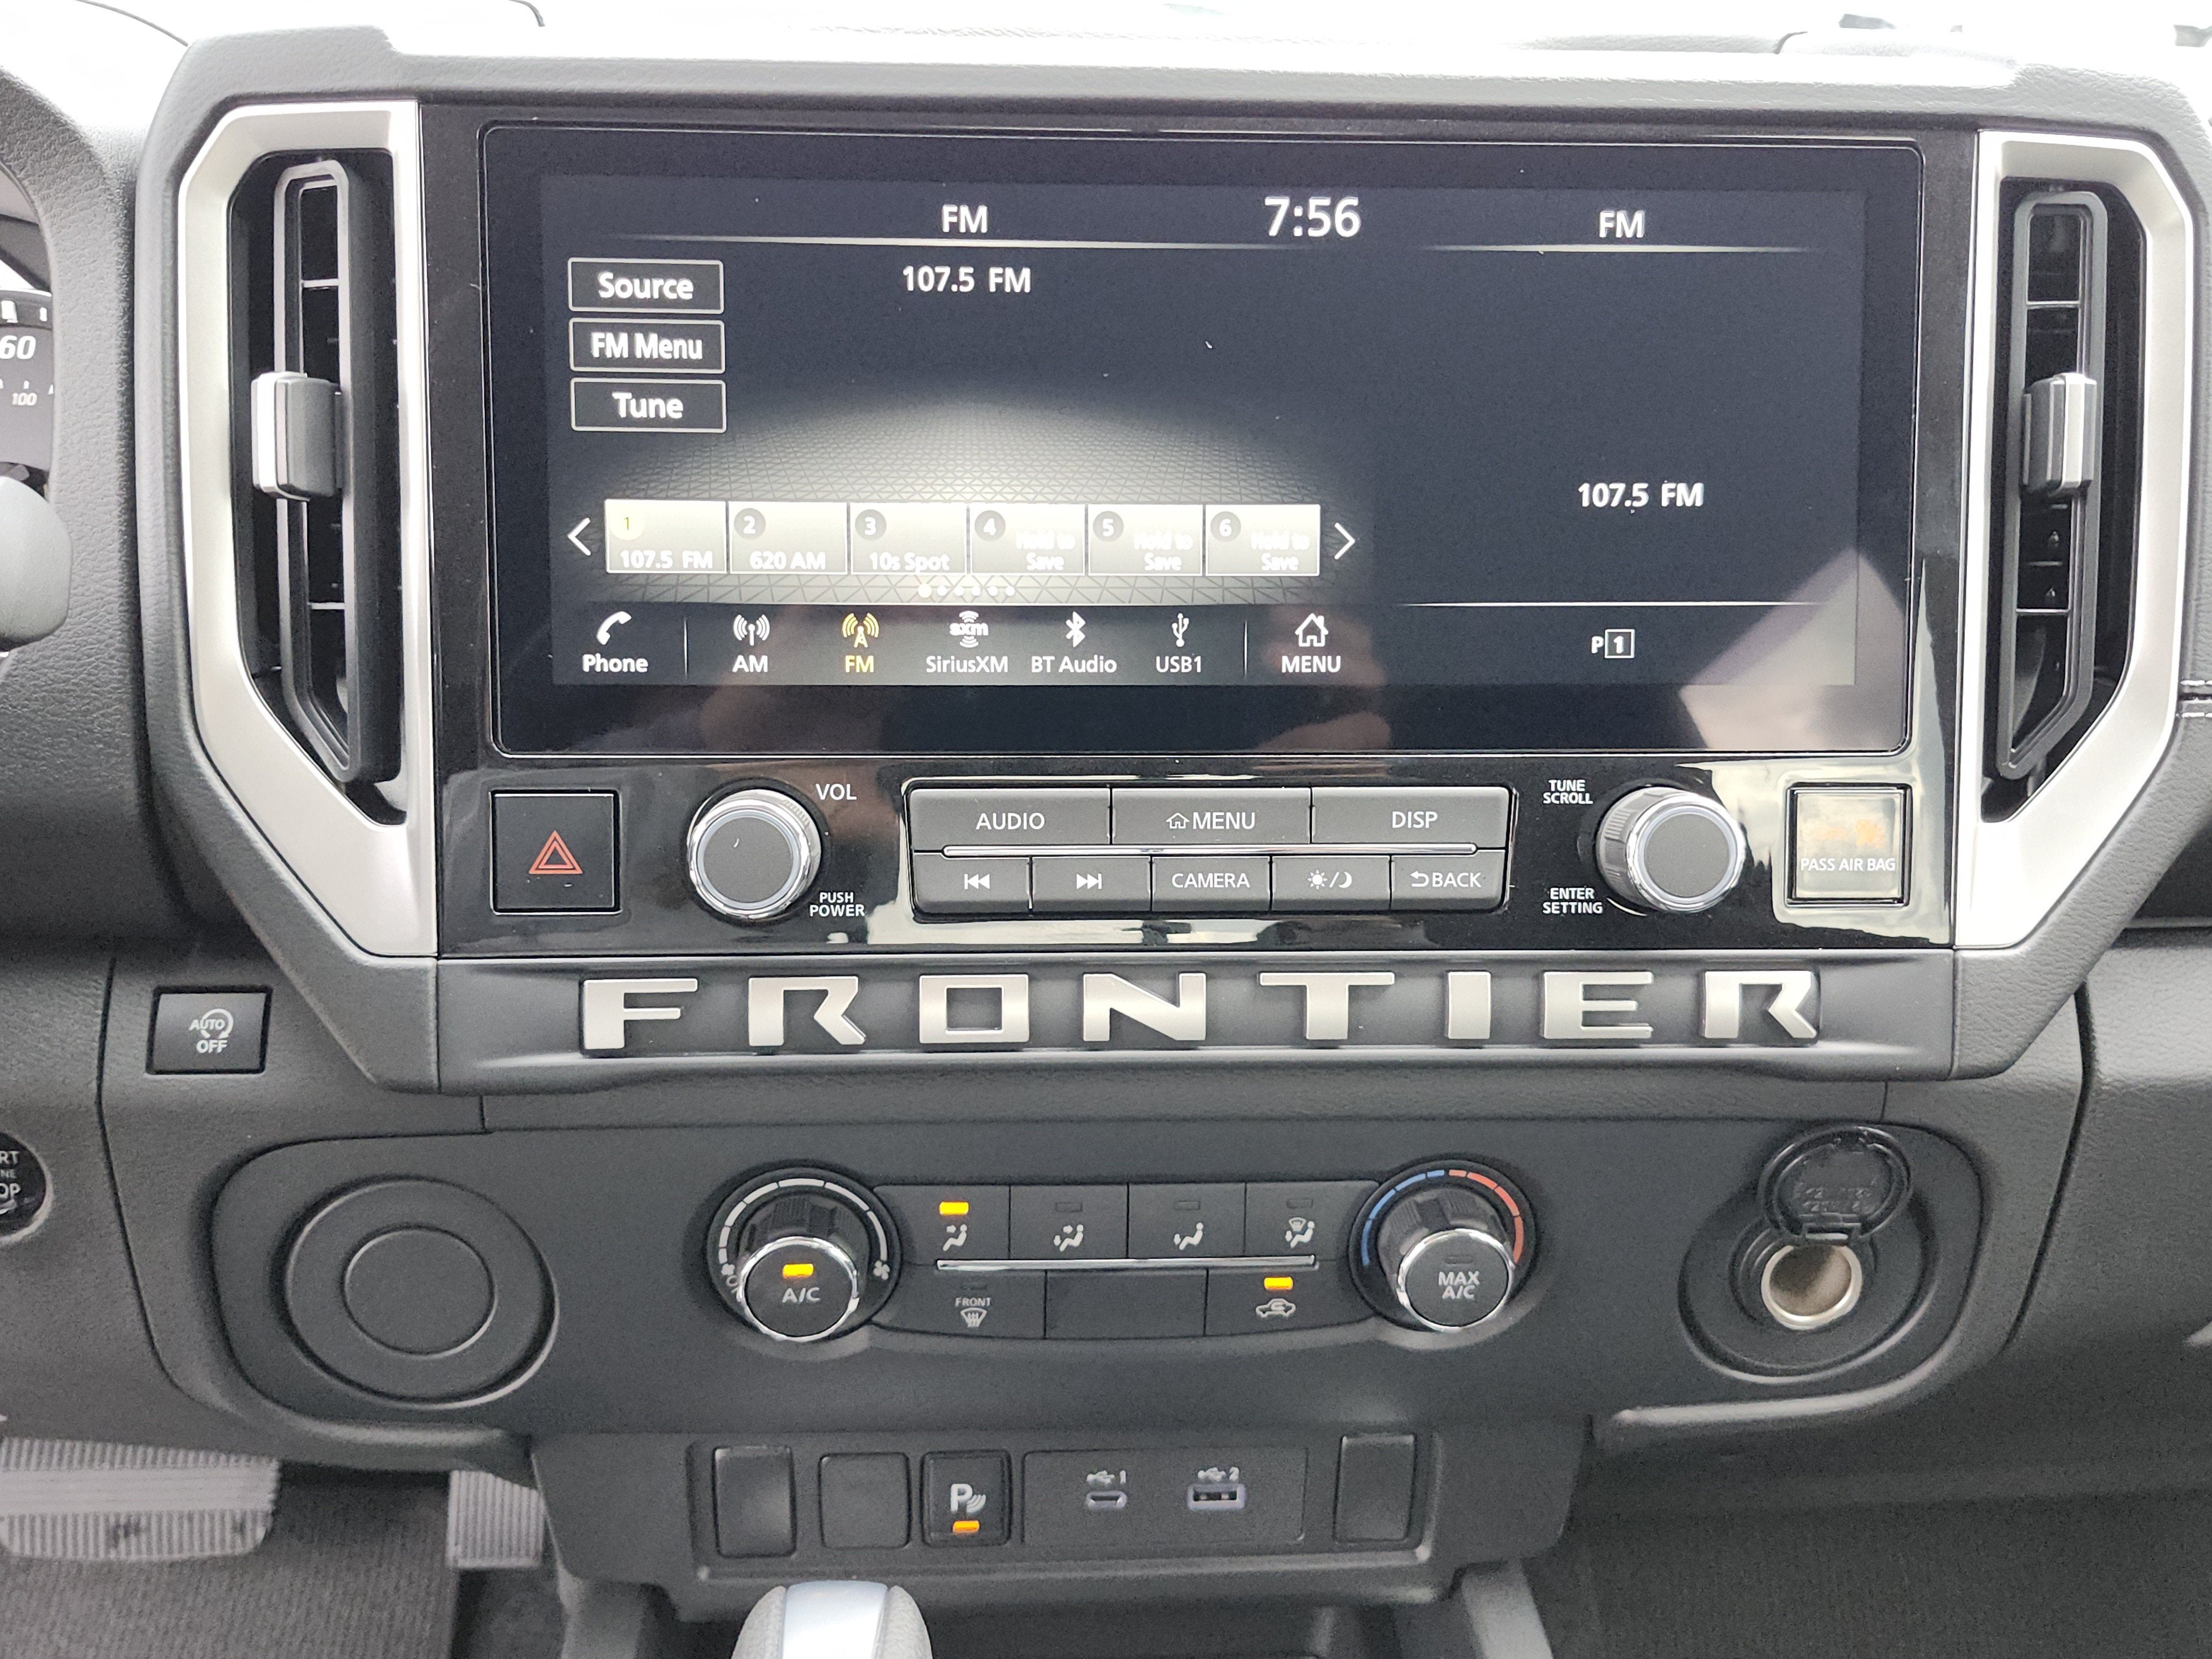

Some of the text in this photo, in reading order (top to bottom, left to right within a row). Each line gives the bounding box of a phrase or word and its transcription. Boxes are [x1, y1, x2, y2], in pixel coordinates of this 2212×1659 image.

[942, 205, 988, 233] FM
[1264, 196, 1360, 238] 7:56
[1599, 210, 1645, 238] FM
[597, 273, 693, 300] Source
[902, 266, 1031, 293] 107.5 FM
[0, 335, 36, 359] 60
[591, 333, 702, 359] FM Menu
[12, 393, 37, 405] 100
[613, 392, 684, 419] Tune
[1578, 482, 1704, 507] 107.5 FM
[623, 517, 630, 531] 1
[743, 516, 756, 534] 2
[864, 517, 877, 536] 3
[983, 518, 996, 535] 4
[1103, 518, 1115, 536] 5
[1219, 519, 1232, 536] 6
[620, 550, 713, 568] 107.5 FM
[749, 551, 826, 570] 620 AM
[869, 552, 950, 574] 10s Spot
[1026, 553, 1064, 571] Save
[1144, 553, 1182, 571] Save
[1261, 553, 1299, 571] Save
[582, 654, 649, 673] Phone
[732, 655, 769, 672] AM
[845, 655, 874, 673] FM
[926, 655, 1008, 673] SiriusXM
[1031, 655, 1117, 673] BT Audio
[1156, 656, 1202, 673] USB1
[1281, 656, 1341, 673] MENU
[816, 784, 857, 801] VOL
[1549, 780, 1585, 792] TUNE
[1543, 792, 1593, 805] SCROLL
[975, 813, 1045, 830] AUDIO
[1192, 812, 1255, 830] MENU
[1392, 811, 1438, 828] DISP
[1801, 858, 1896, 872] PASS AIR BAG
[1172, 873, 1250, 888] CAMERA
[1432, 872, 1481, 888] BACK
[819, 892, 854, 904] PUSH
[1550, 888, 1594, 900] ENTER
[810, 904, 865, 917] POWER
[1542, 901, 1603, 914] SETTING
[583, 971, 1818, 1050] FRONTIER
[189, 1019, 226, 1030] AUTO
[196, 1040, 228, 1053] OFF
[1438, 1271, 1480, 1286] MAX
[782, 1287, 821, 1303] A/C
[1441, 1285, 1475, 1300] A/C
[955, 1297, 992, 1307] FRONT
